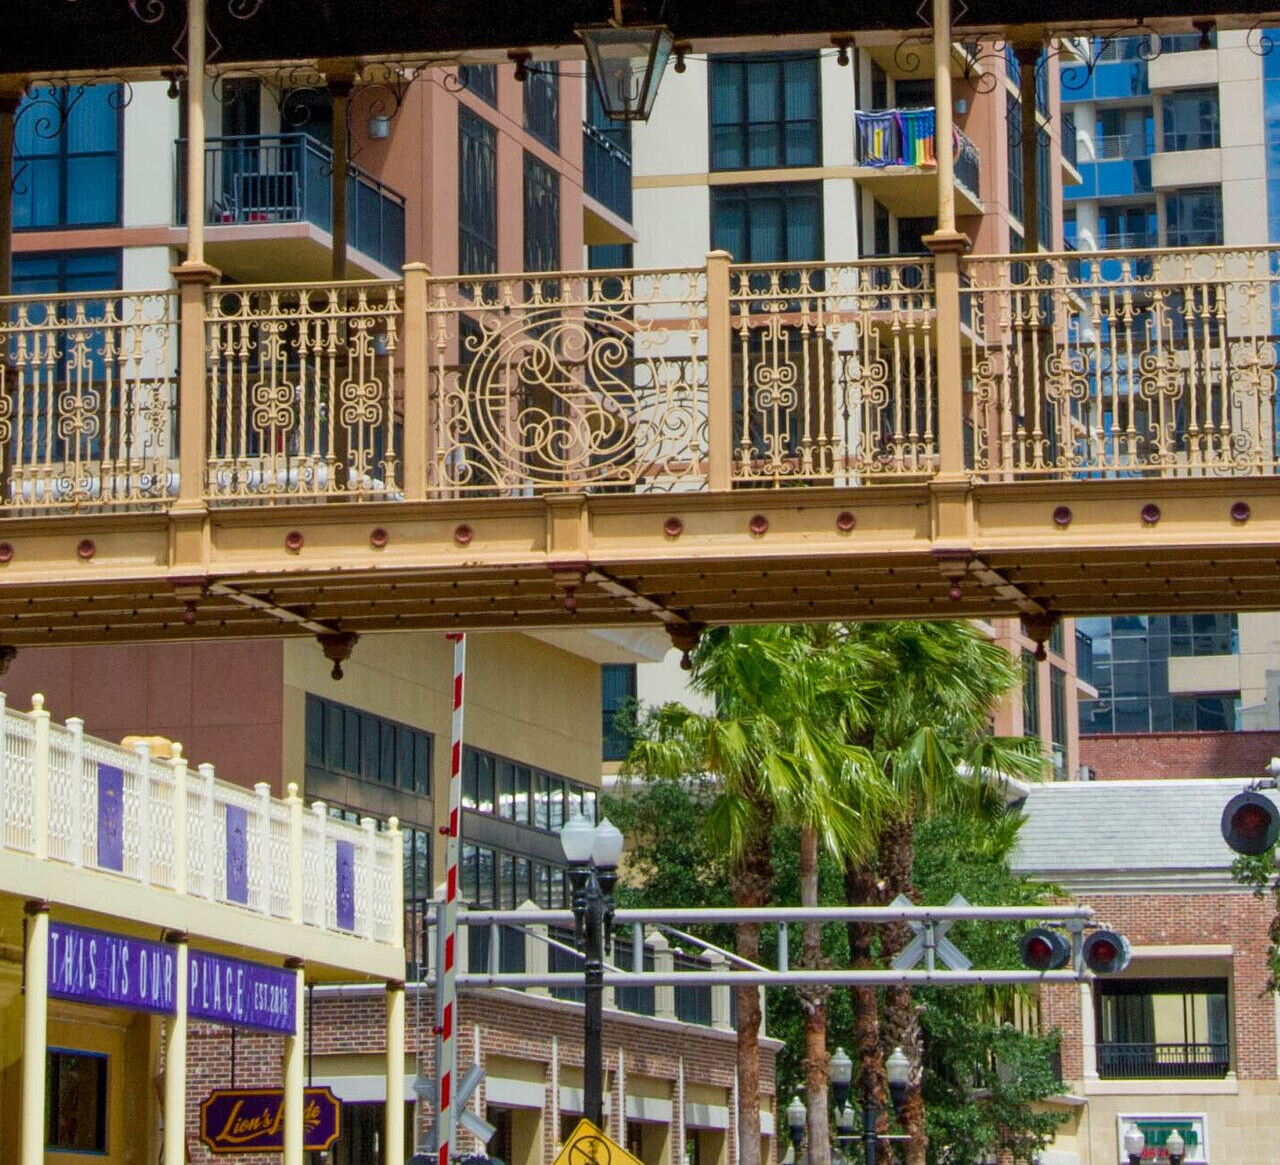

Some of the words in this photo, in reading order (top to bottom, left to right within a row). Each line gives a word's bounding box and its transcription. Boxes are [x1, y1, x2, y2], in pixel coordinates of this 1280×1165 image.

[51, 933, 97, 990] THIS
[112, 945, 129, 995] IS
[139, 950, 173, 1003] OUR
[191, 960, 244, 1015] PLACE
[216, 1100, 273, 1143] Lion's
